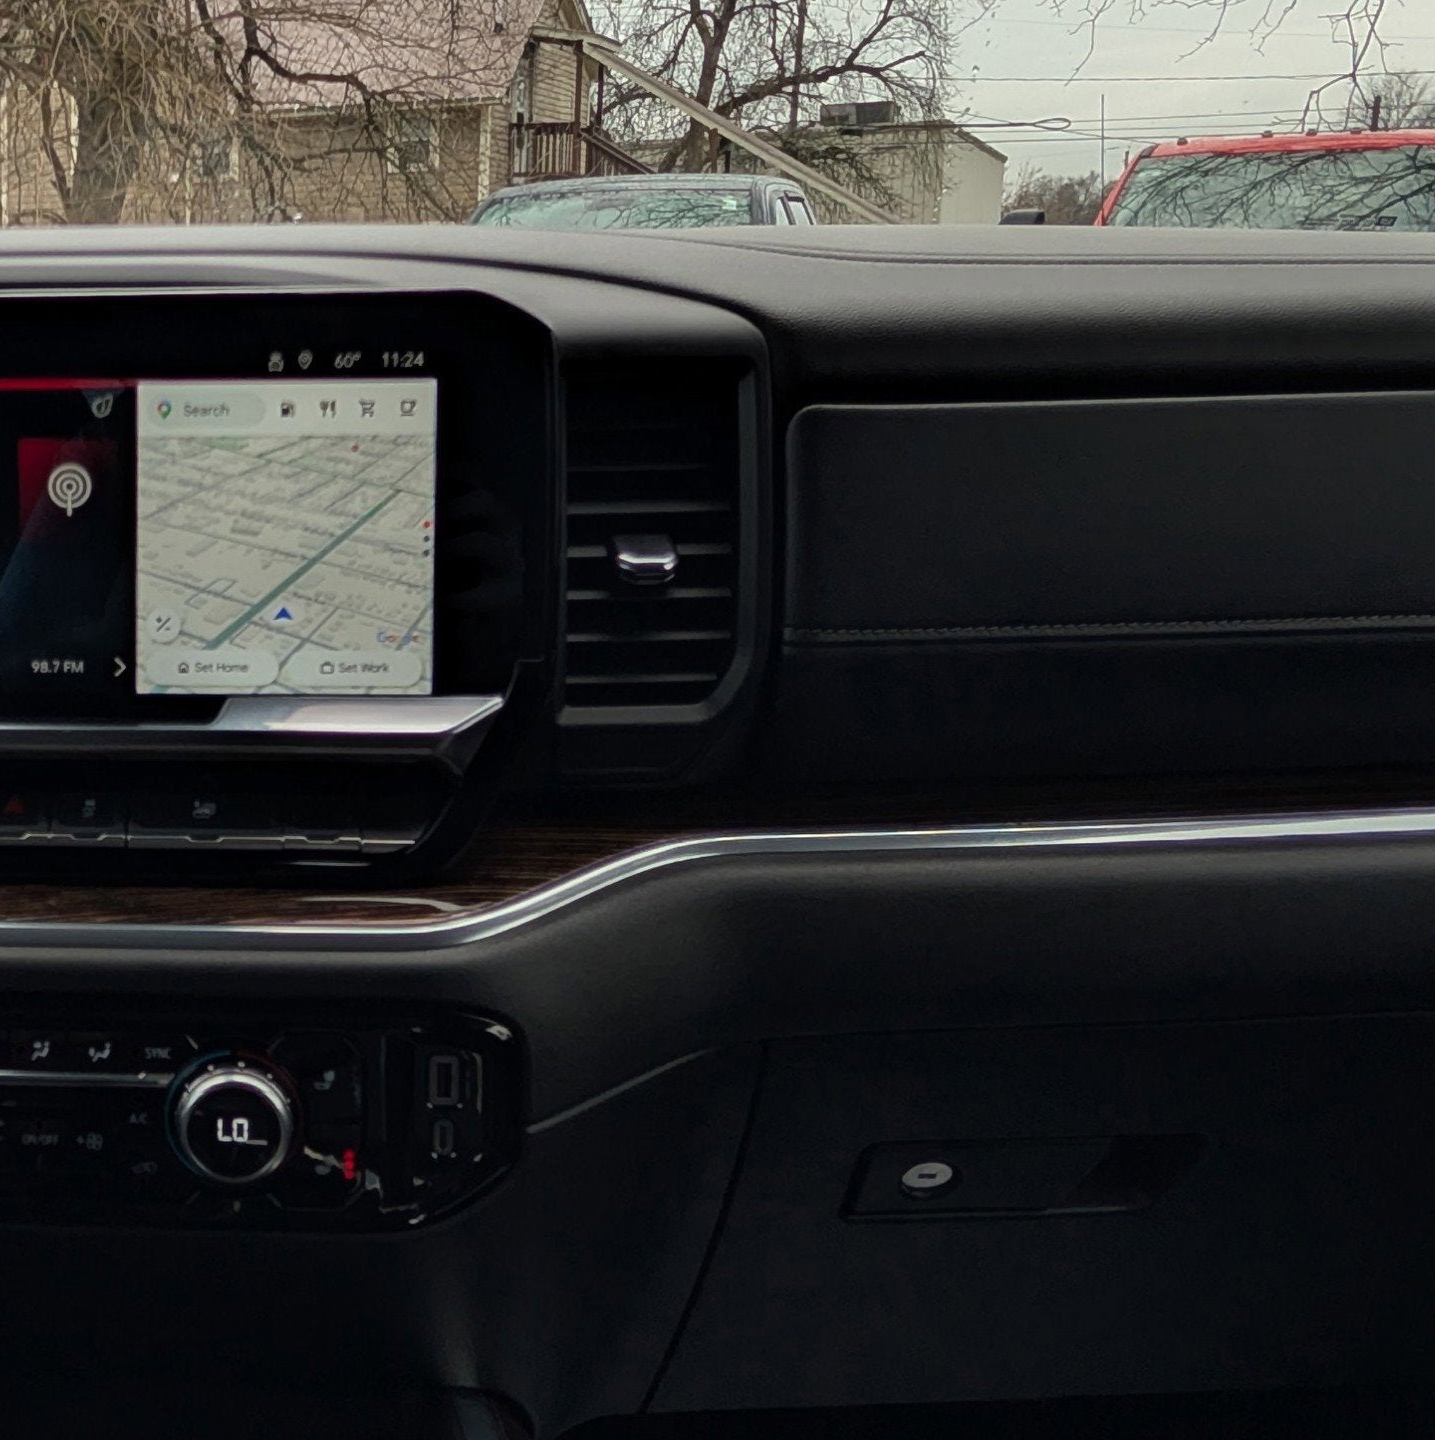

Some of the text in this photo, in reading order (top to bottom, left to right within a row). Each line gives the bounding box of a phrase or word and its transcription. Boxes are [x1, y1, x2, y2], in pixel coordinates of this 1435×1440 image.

[382, 351, 424, 368] 11:24
[183, 401, 230, 417] Search
[31, 658, 84, 674] 98.7 FM
[195, 661, 249, 674] Set Home
[338, 661, 389, 674] Set Work
